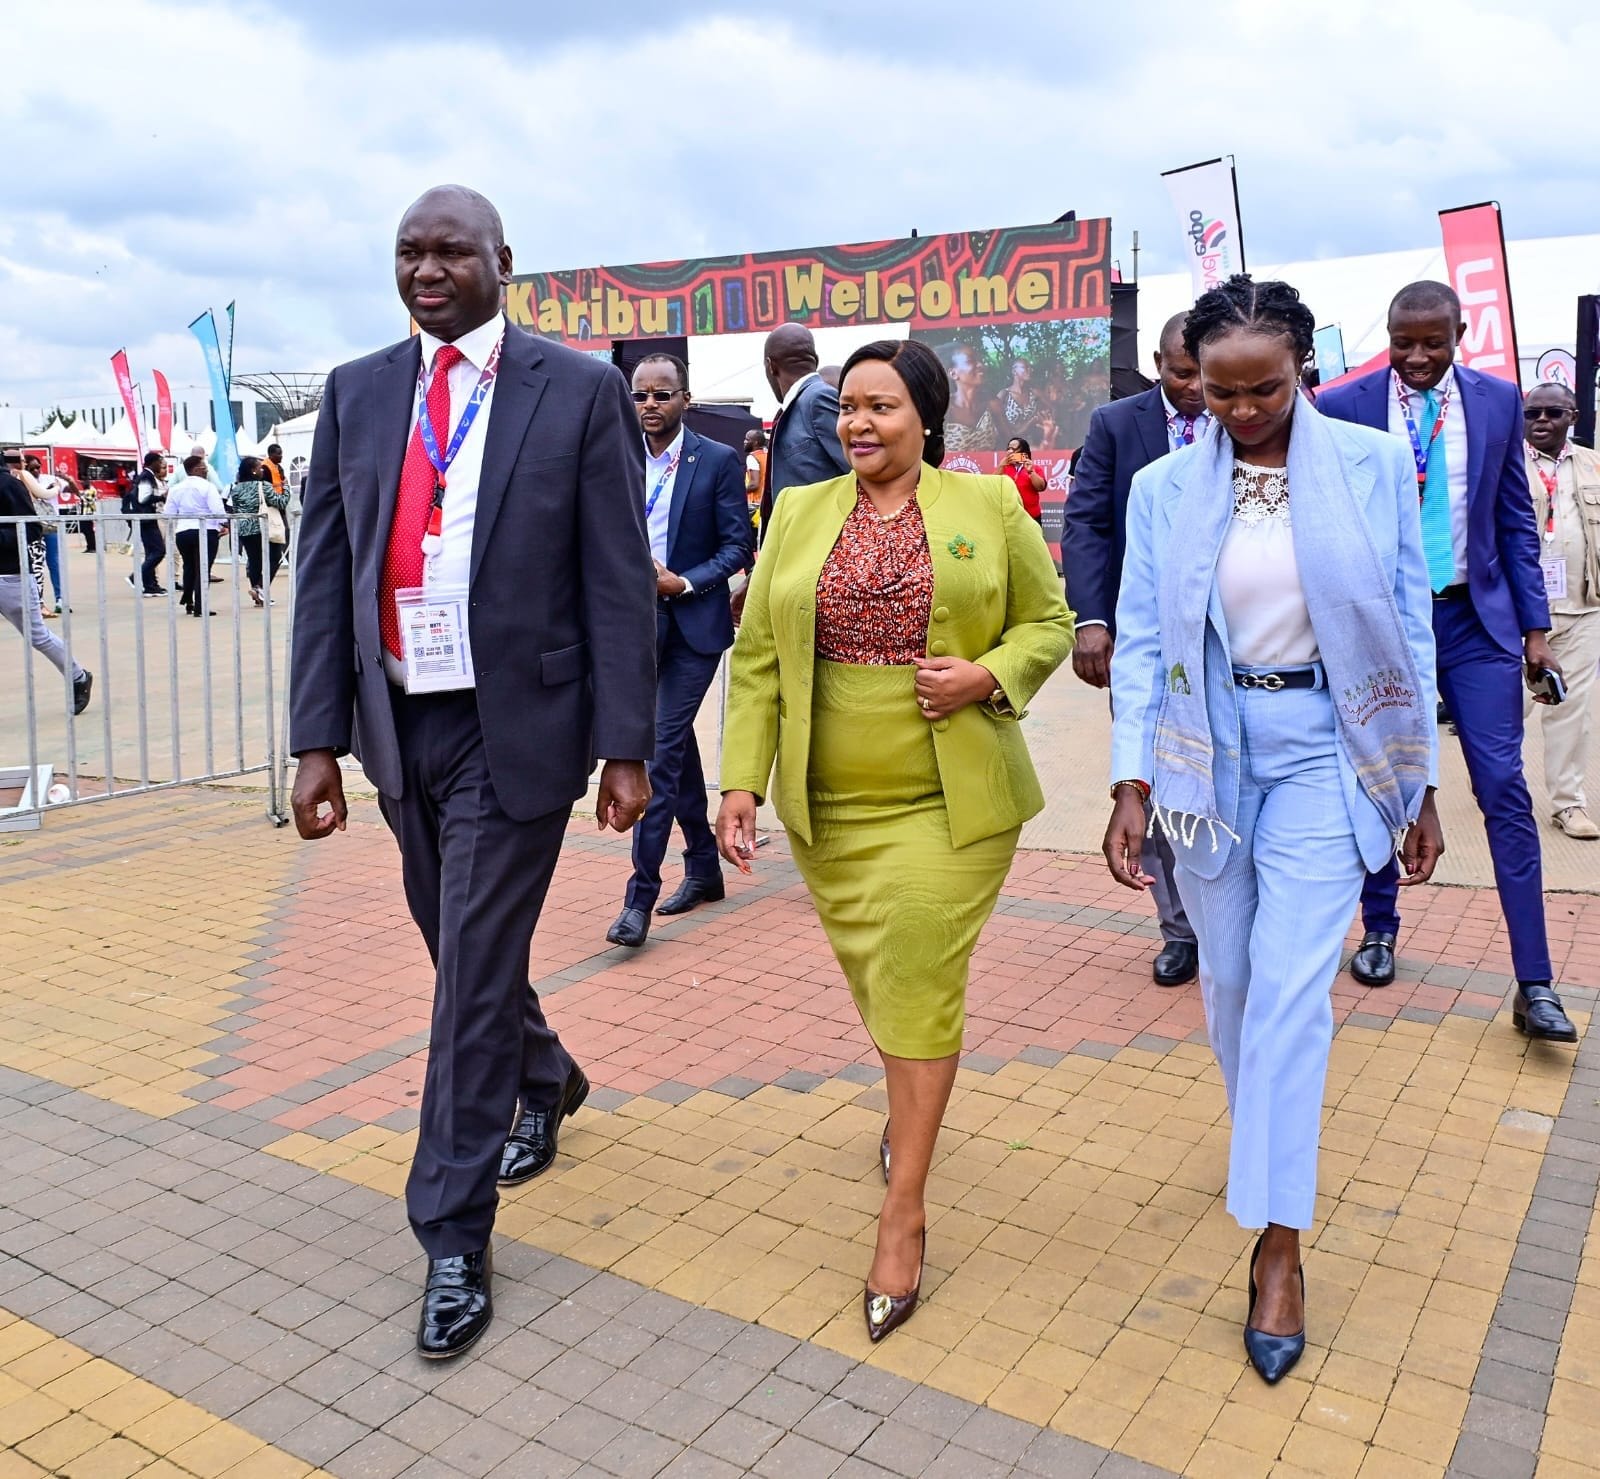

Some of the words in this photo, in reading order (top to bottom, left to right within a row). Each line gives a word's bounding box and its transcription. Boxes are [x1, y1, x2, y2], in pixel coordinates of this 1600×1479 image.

[506, 282, 667, 335] Karibu
[784, 263, 1050, 319] Welcome
[1048, 478, 1071, 495] exp
